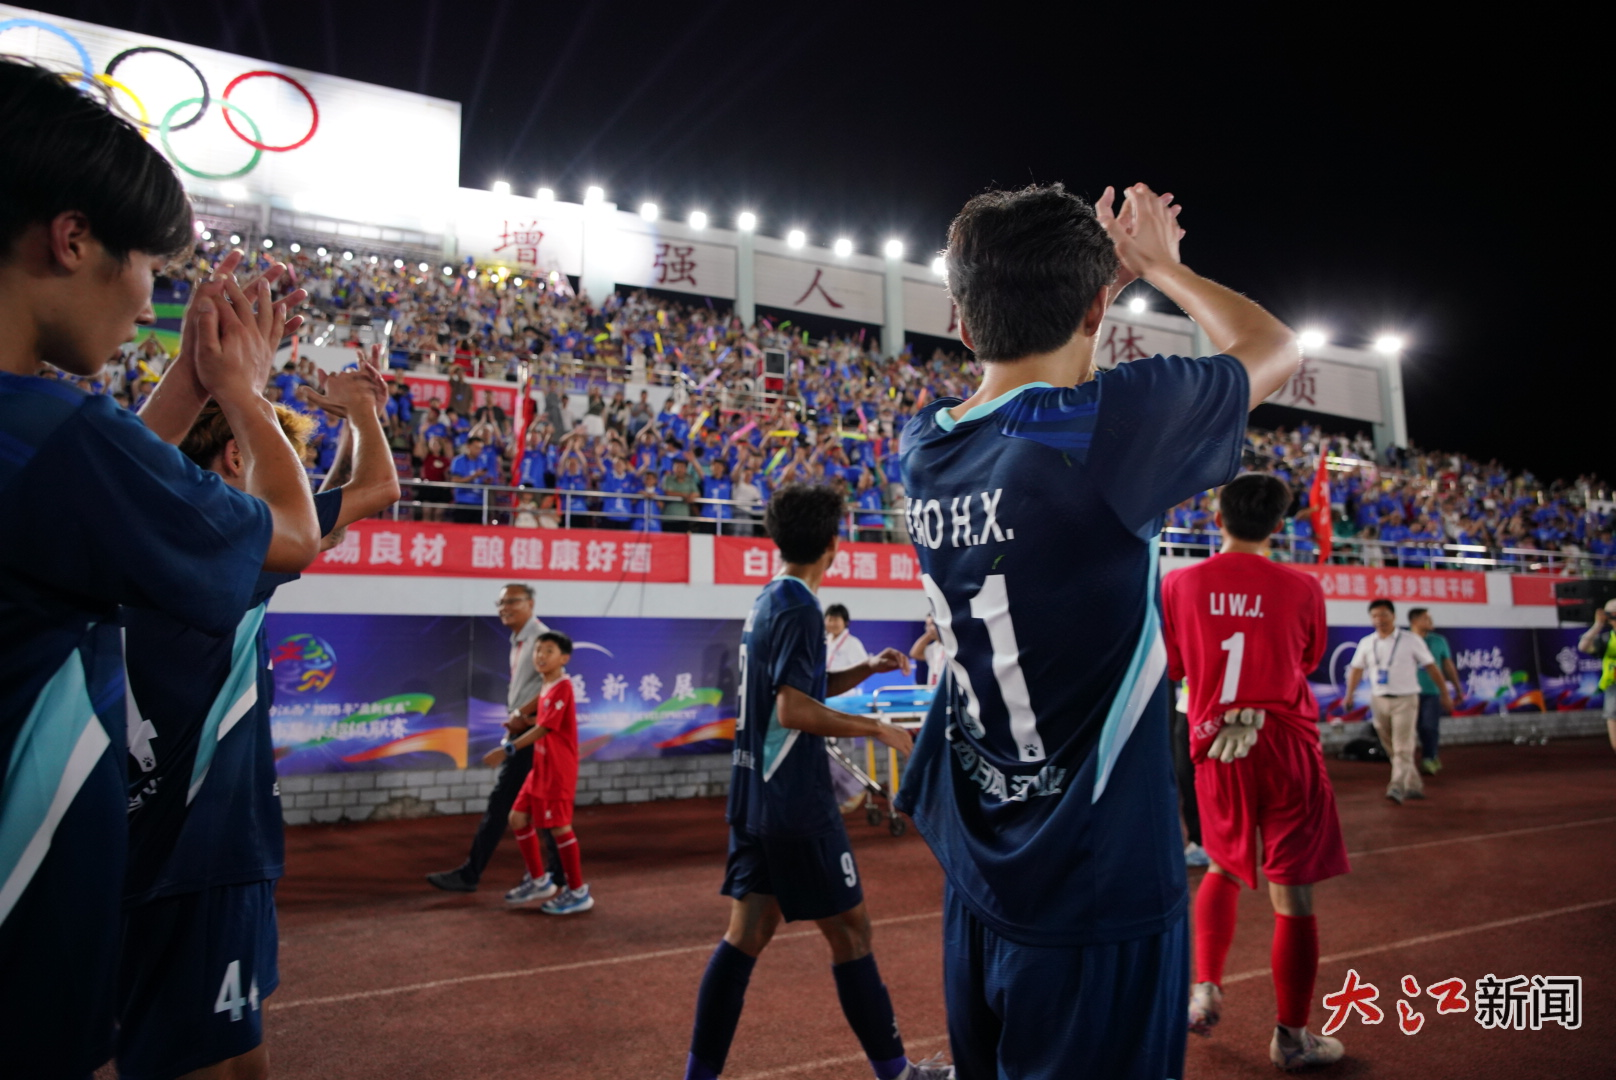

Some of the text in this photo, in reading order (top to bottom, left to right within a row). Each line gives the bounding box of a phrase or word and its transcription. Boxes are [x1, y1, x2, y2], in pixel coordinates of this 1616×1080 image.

[951, 488, 1015, 548] H.X.
[472, 535, 653, 574] 酿健康好酒
[1210, 591, 1264, 618] LI W.J.
[1219, 631, 1245, 704] 1
[840, 851, 857, 888] 9
